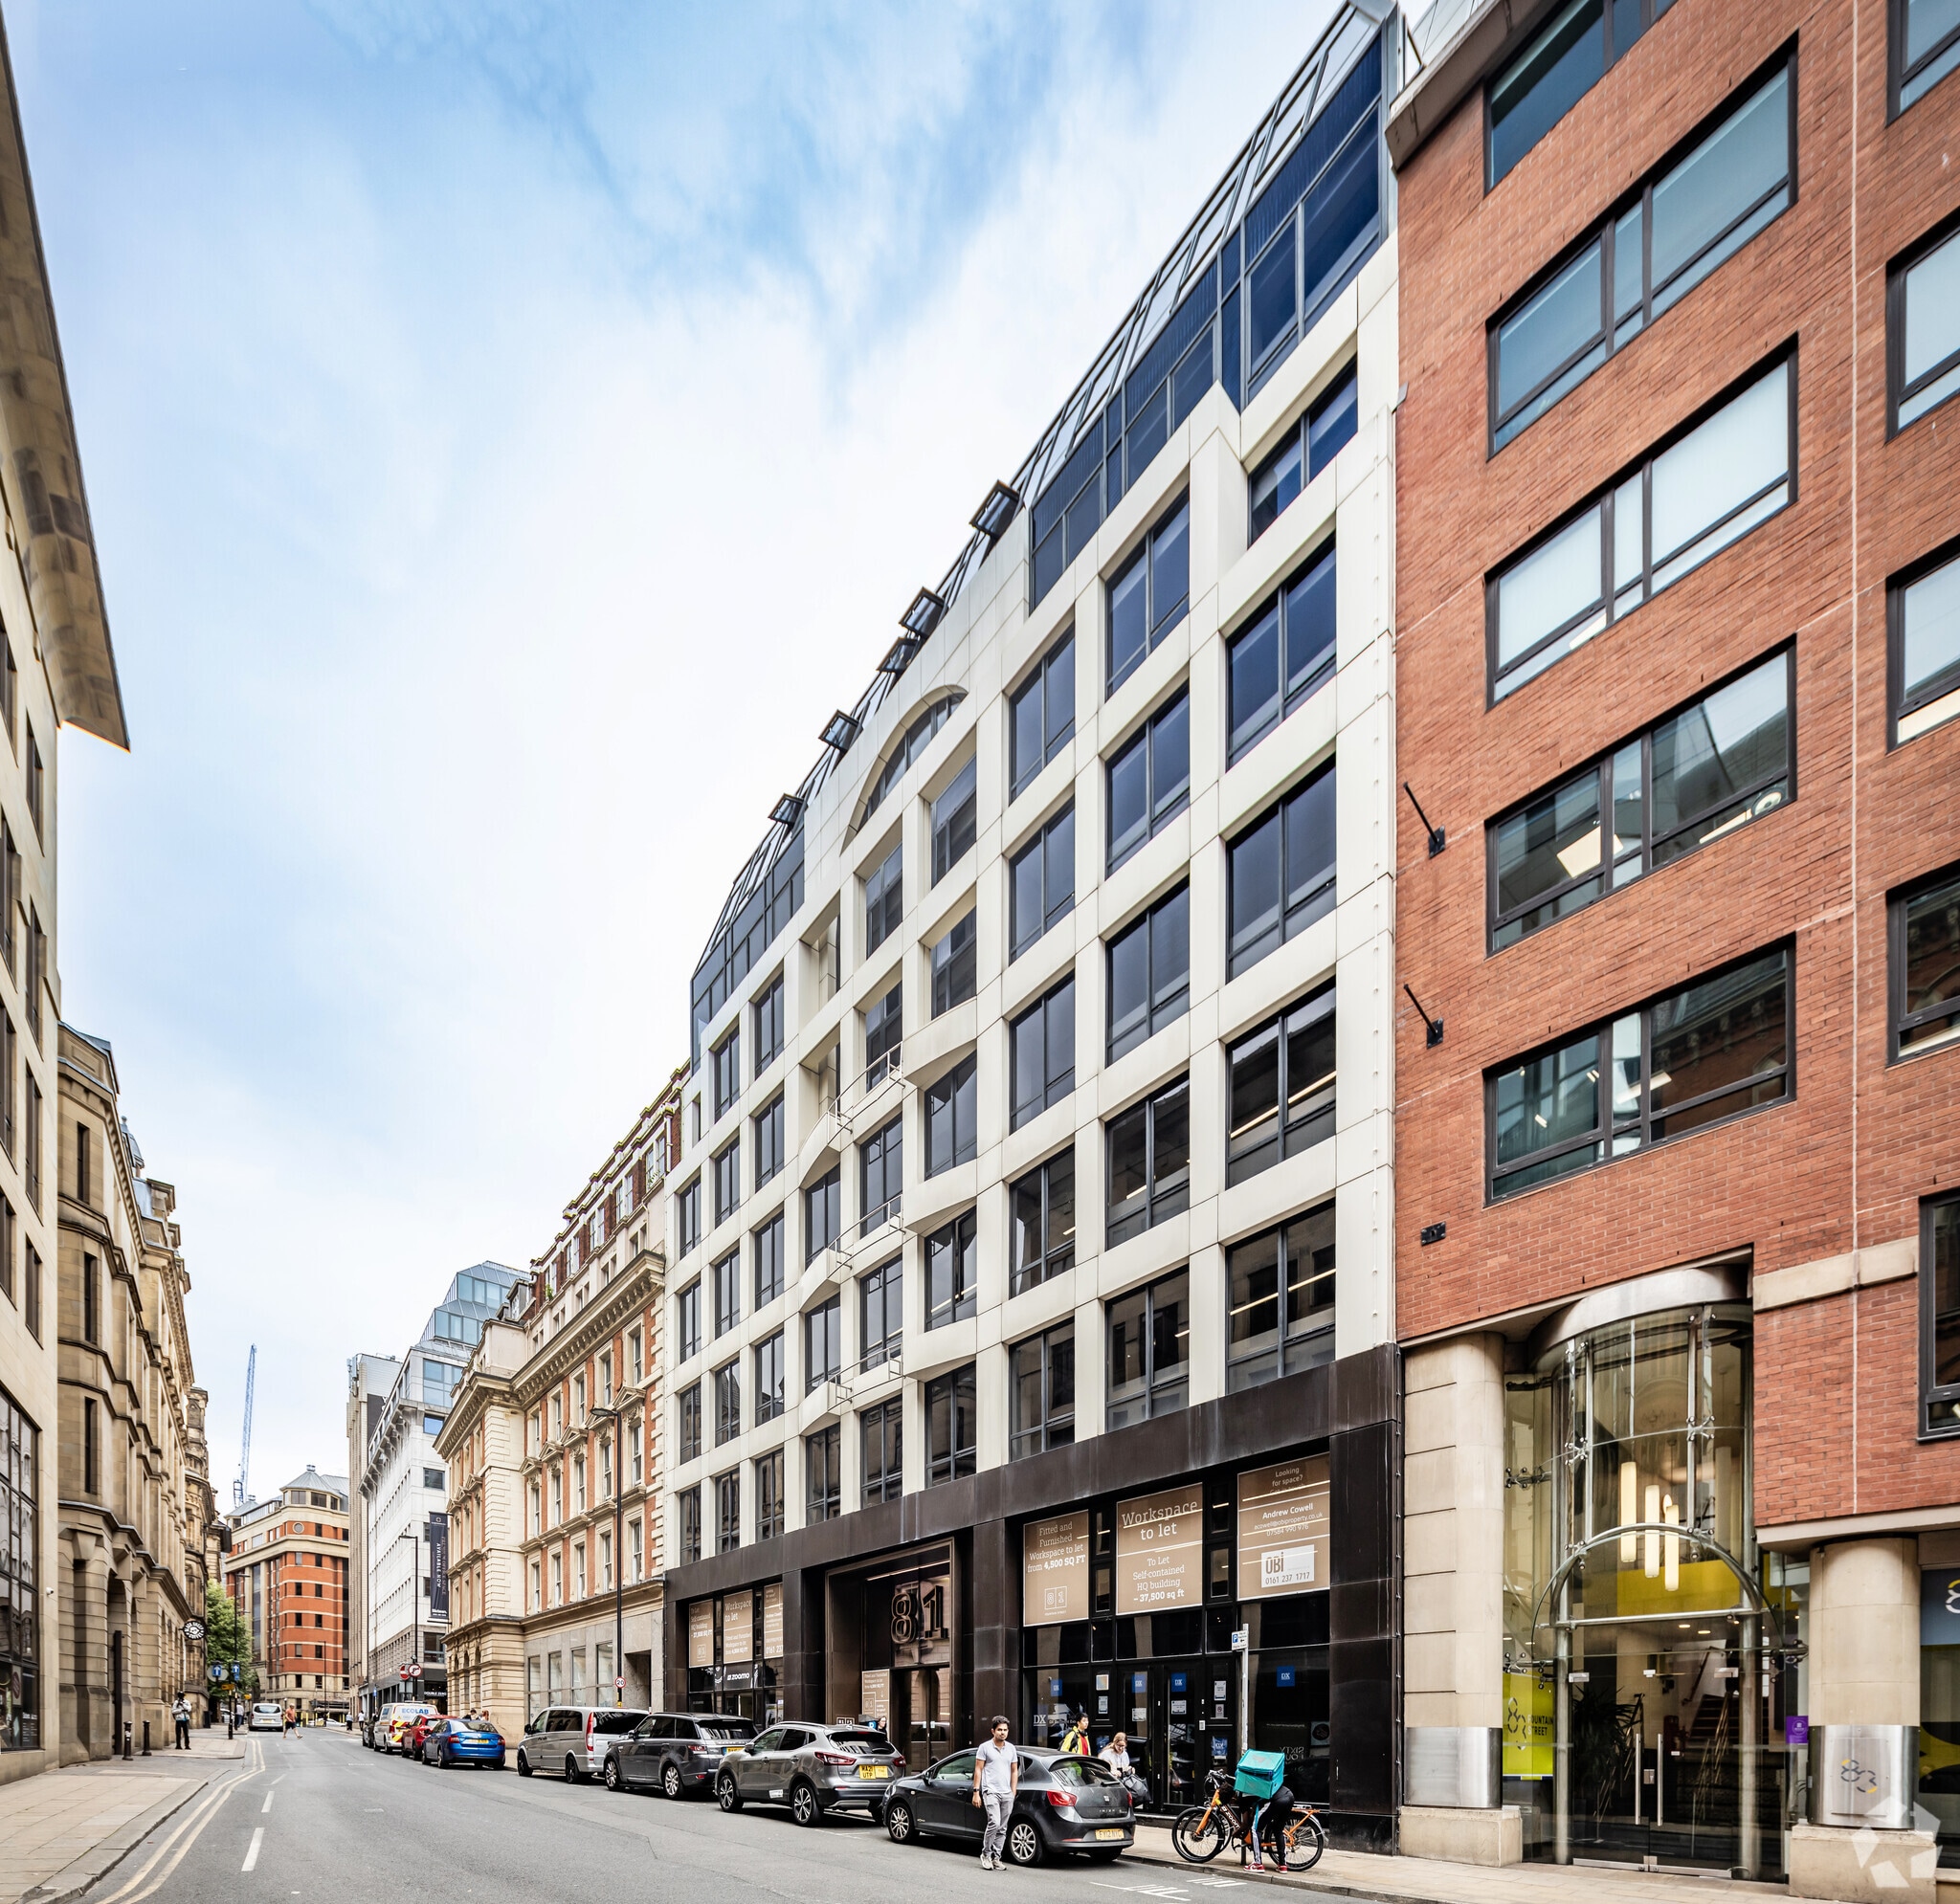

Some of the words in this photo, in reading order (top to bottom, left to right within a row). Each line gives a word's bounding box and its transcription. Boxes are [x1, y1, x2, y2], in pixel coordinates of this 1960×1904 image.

[1276, 1468, 1299, 1477] Looking
[1282, 1474, 1303, 1485] space?
[1122, 1501, 1197, 1526] Workspace
[1263, 1509, 1289, 1519] Andrew
[1290, 1503, 1314, 1514] Cowell
[1039, 1525, 1058, 1536] Fitted
[1059, 1521, 1072, 1531] and
[1141, 1528, 1154, 1540] to
[1158, 1522, 1177, 1538] let
[1040, 1534, 1072, 1548] Furnished
[1029, 1548, 1065, 1561] Workspace
[1074, 1544, 1084, 1552] let
[1027, 1564, 1043, 1572] from
[1044, 1559, 1063, 1570] 4,500
[1065, 1557, 1074, 1566] SQ
[1076, 1554, 1086, 1563] FT
[1147, 1558, 1156, 1567] To
[1158, 1556, 1169, 1565] Let
[1133, 1564, 1185, 1580] Self-contained
[1265, 1576, 1279, 1584] 0161
[1296, 1572, 1310, 1580] 1717
[1137, 1582, 1148, 1591] HQ
[1150, 1579, 1180, 1589] building
[1140, 1592, 1165, 1602] 37,500
[1167, 1591, 1176, 1600] sq
[1177, 1588, 1184, 1597] ft
[724, 1600, 752, 1611] Workspace
[891, 1585, 948, 1644] 81
[1034, 1714, 1047, 1724] DX
[1528, 1715, 1554, 1724] FOUNTAIN
[1528, 1726, 1548, 1736] STREET
